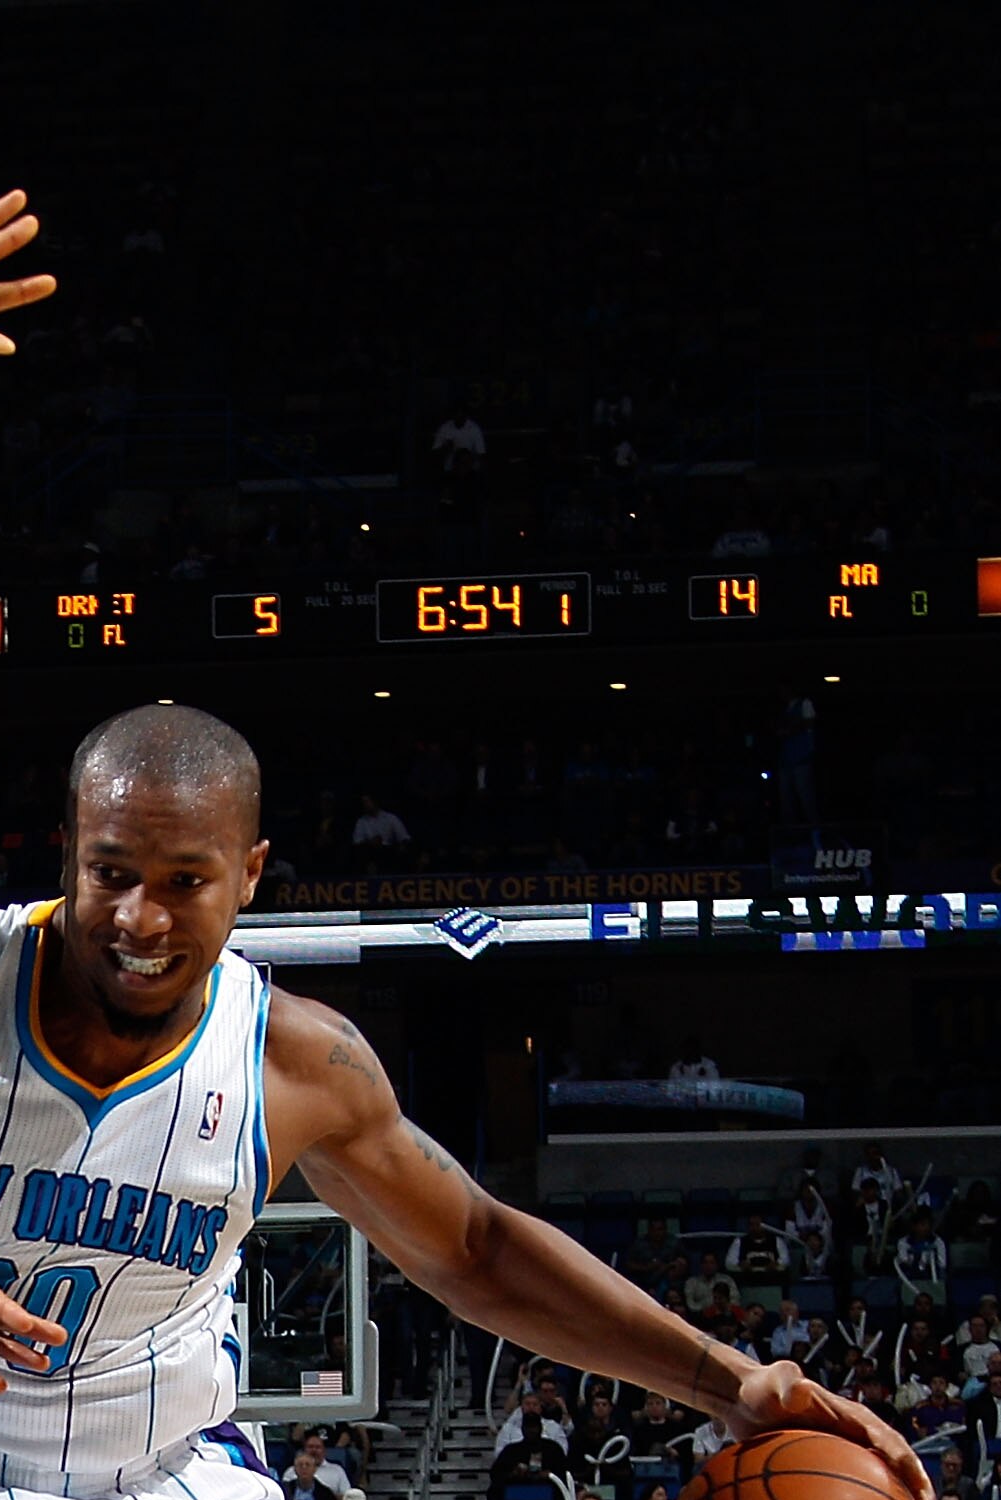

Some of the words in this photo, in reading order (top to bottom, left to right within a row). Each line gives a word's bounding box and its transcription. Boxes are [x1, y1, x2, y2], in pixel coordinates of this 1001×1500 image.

[417, 584, 522, 633] 6:54
[560, 592, 572, 627] 1
[718, 579, 757, 615] 14
[829, 594, 853, 619] FL
[253, 595, 279, 636] 5
[103, 623, 126, 646] FL
[814, 847, 873, 870] HUB
[376, 878, 492, 903] AGENCY
[501, 876, 538, 900] OF
[543, 874, 599, 899] THE
[608, 870, 743, 898] HORNETS
[13, 1168, 229, 1276] ORLEANS
